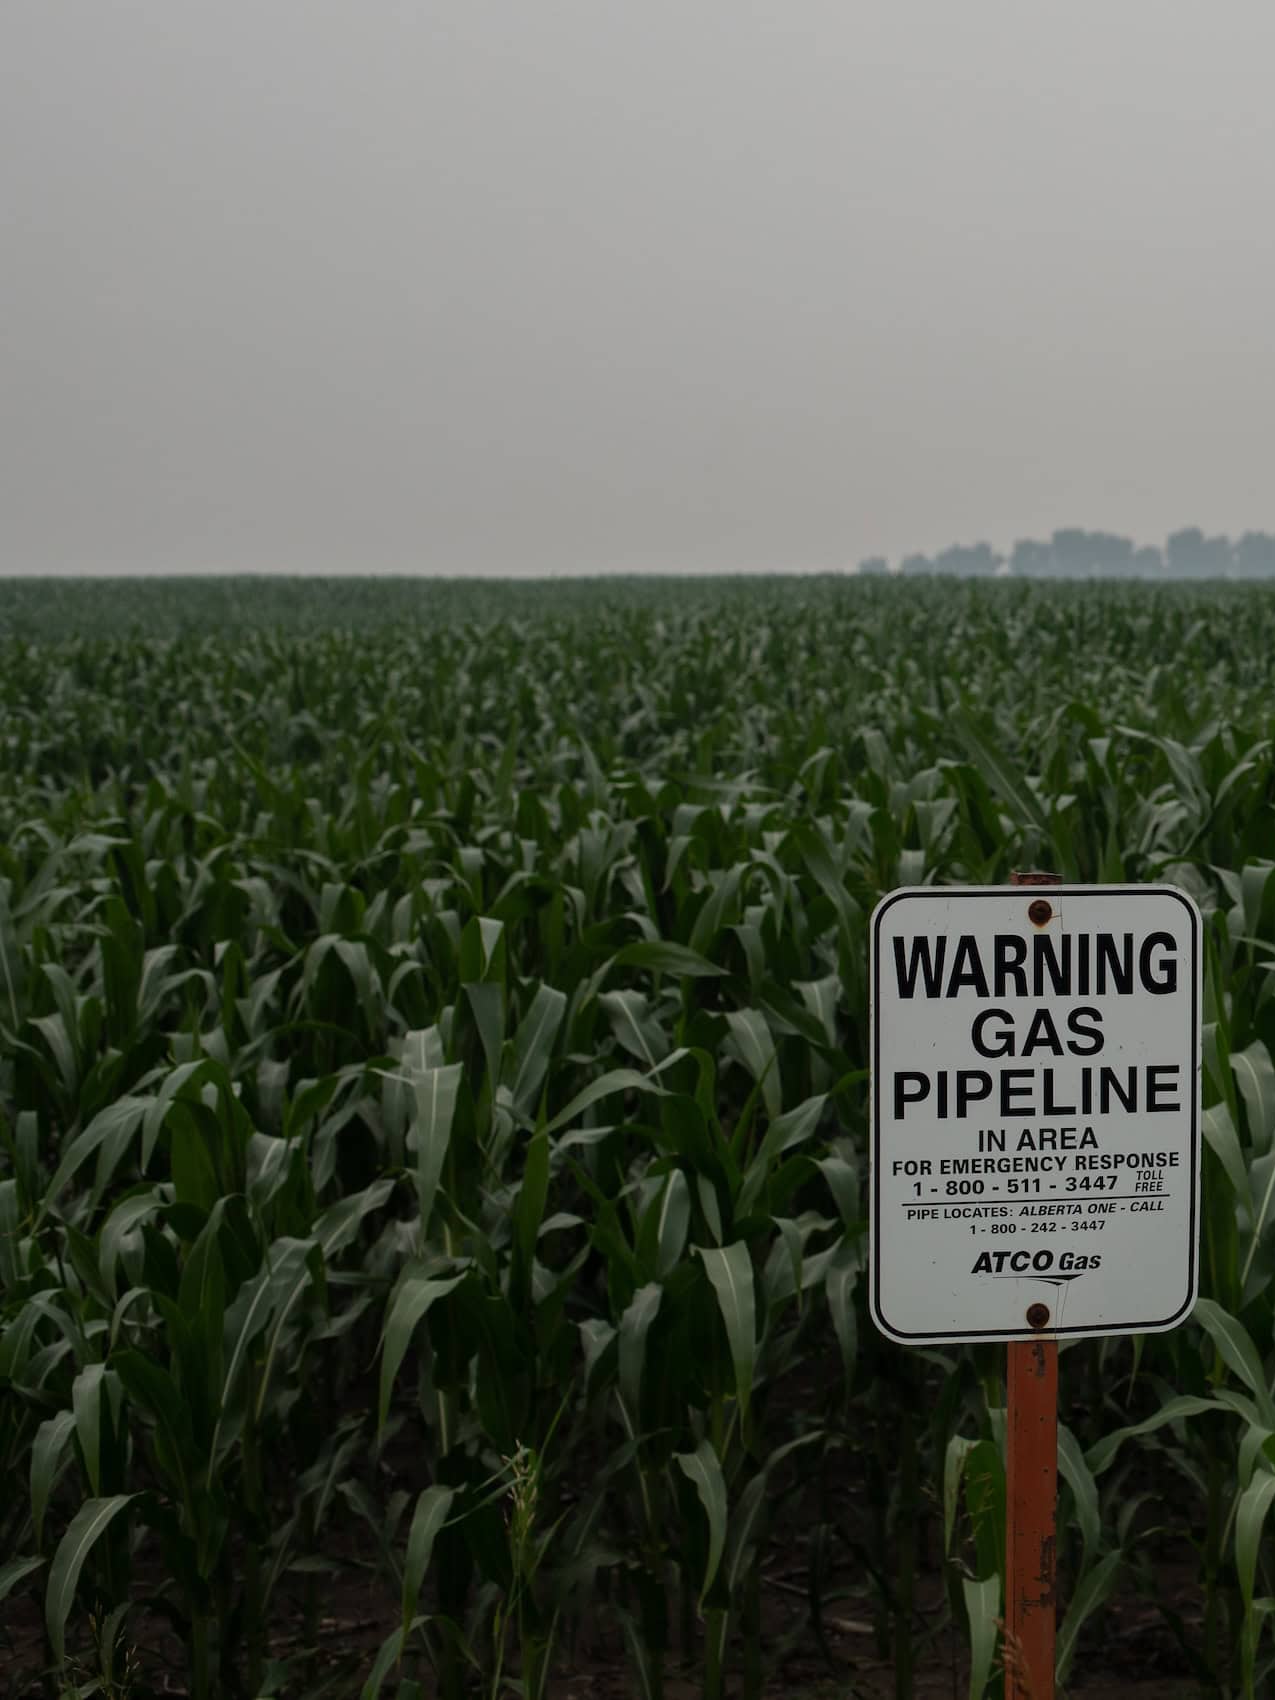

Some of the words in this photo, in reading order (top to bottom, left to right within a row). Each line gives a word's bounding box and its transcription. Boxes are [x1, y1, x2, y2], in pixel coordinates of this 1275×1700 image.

[892, 931, 1178, 999] WARNING
[971, 1006, 1105, 1059] GAS
[893, 1064, 1181, 1121] PIPELINE
[978, 1129, 1006, 1153] IN
[1016, 1126, 1099, 1152] AREA
[892, 1160, 932, 1177] FOR
[940, 1156, 1068, 1175] EMERGENCY
[1075, 1151, 1180, 1171] RESPONSE
[1136, 1169, 1165, 1181] TOLL
[1134, 1180, 1163, 1193] FREE
[907, 1208, 940, 1221] PIPE
[943, 1206, 1014, 1219] LOCATES:
[1018, 1203, 1083, 1217] ALBERTA
[1087, 1202, 1117, 1214] ONE
[1129, 1200, 1164, 1213] CALL
[970, 1249, 1054, 1274] ATCO
[1058, 1251, 1102, 1271] Gas
